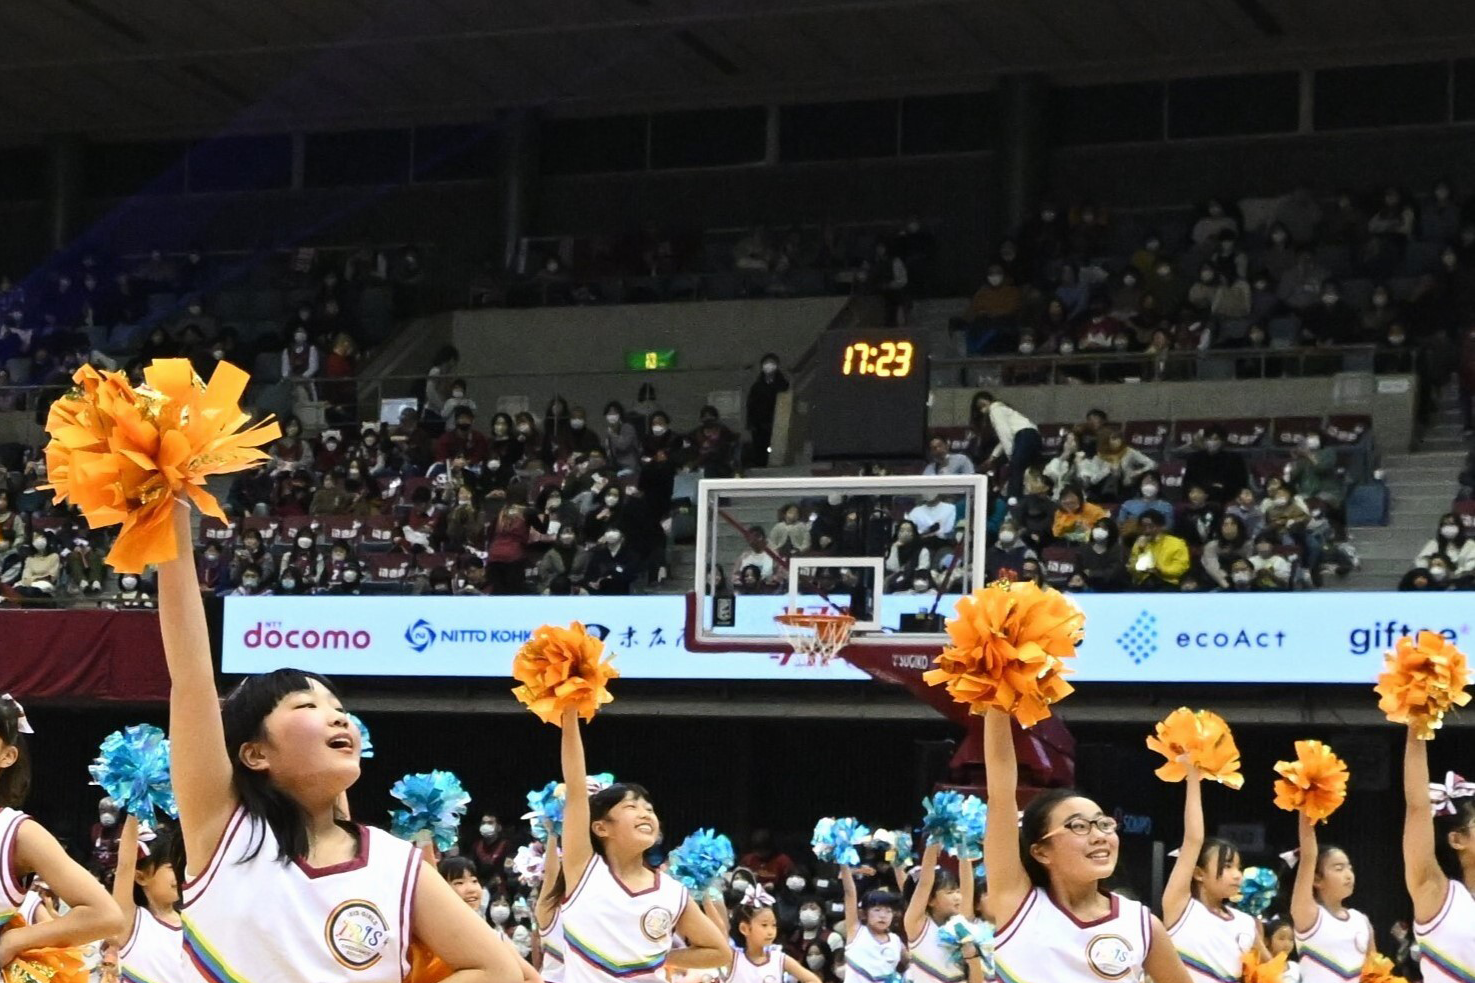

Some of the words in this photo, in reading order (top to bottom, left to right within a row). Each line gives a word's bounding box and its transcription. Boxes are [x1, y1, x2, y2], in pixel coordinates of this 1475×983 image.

[843, 341, 913, 377] 17:23
[243, 622, 371, 649] docomo
[441, 630, 487, 642] NITTO
[490, 630, 532, 642] KOHK
[1176, 630, 1286, 648] ecoAct
